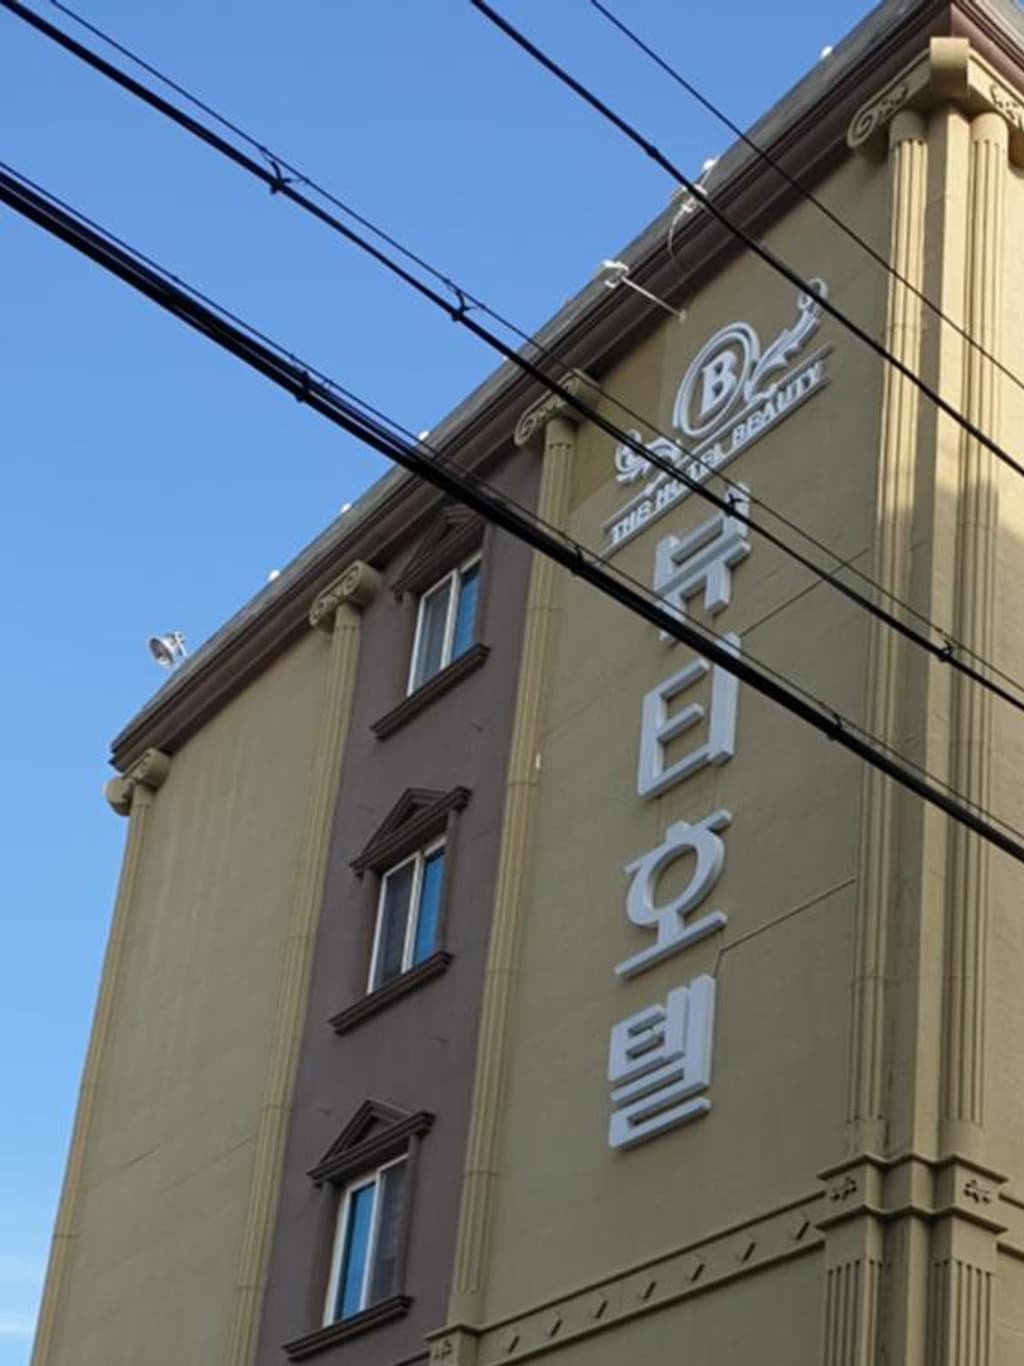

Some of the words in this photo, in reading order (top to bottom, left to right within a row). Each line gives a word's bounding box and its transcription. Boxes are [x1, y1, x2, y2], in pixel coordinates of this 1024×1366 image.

[700, 350, 738, 418] B
[611, 499, 653, 544] THE
[731, 361, 824, 451] BEAUTY
